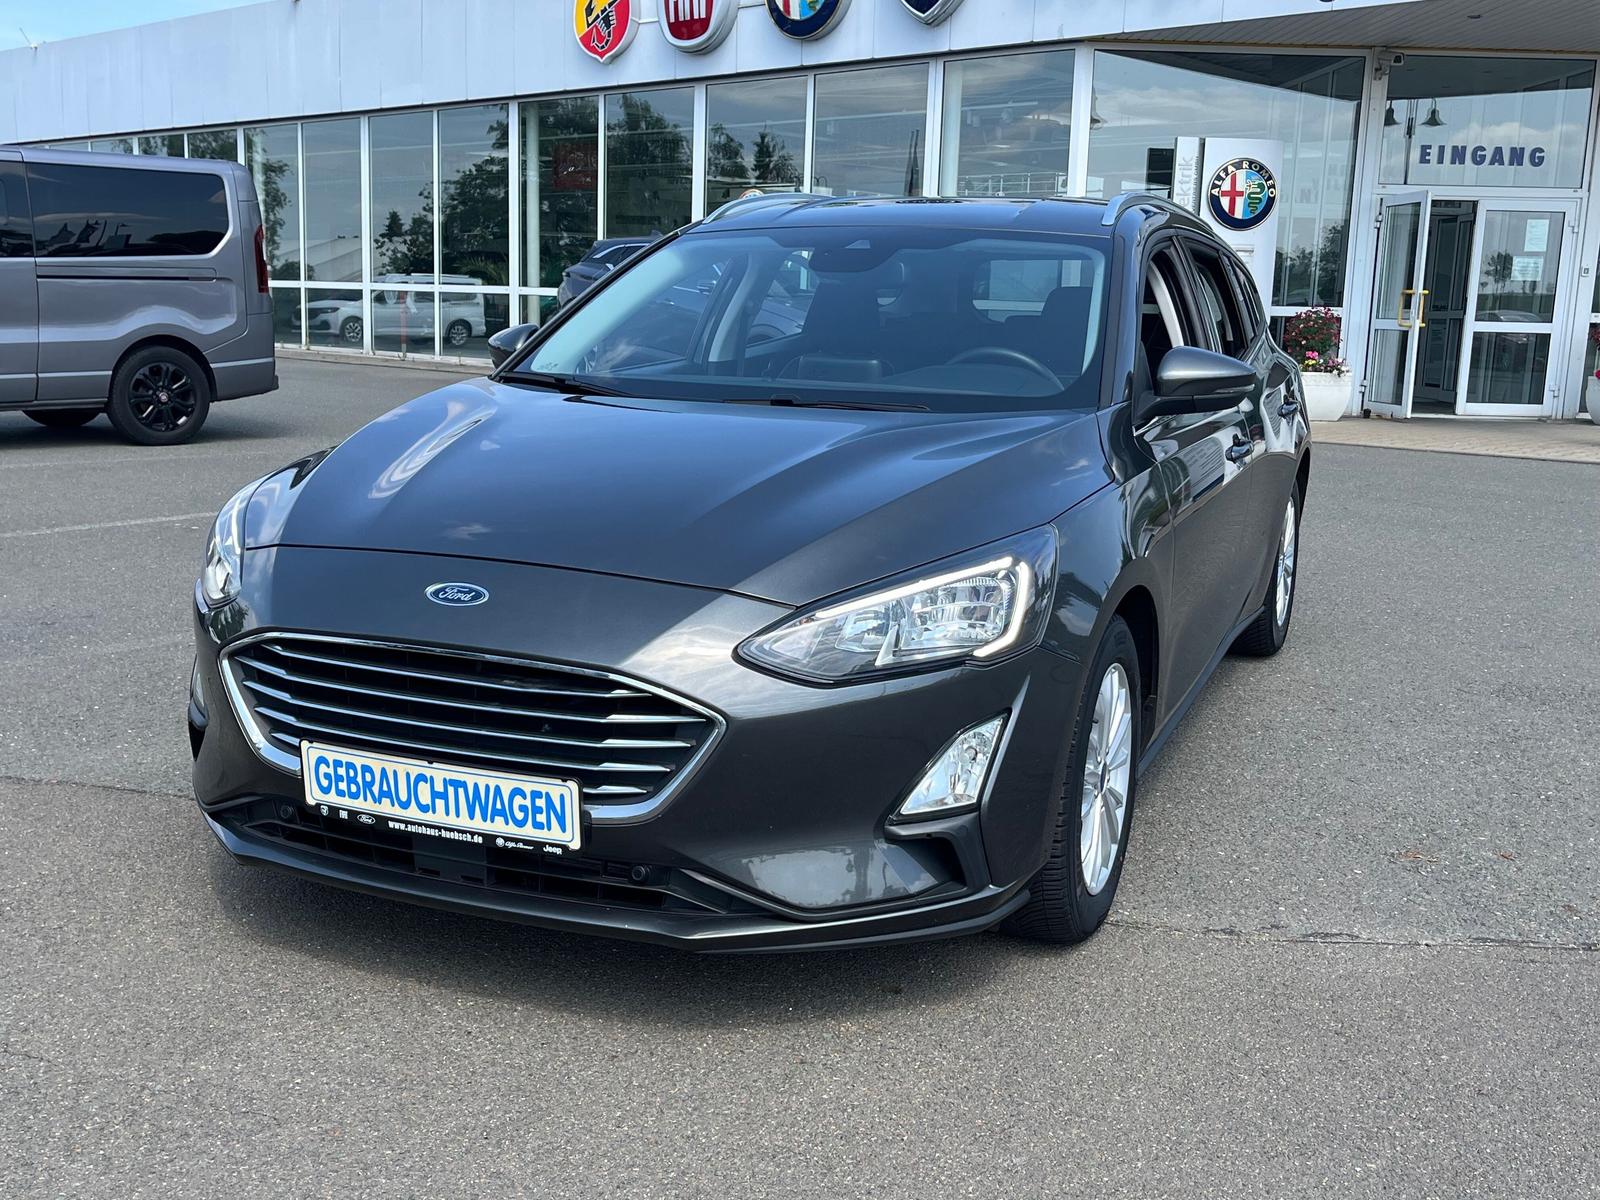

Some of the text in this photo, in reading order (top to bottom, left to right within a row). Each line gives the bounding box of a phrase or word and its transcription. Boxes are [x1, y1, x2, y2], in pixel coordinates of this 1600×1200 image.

[1419, 145, 1545, 167] EINGANG
[1211, 165, 1236, 197] ALFA
[1242, 161, 1276, 197] ROMEO
[438, 586, 475, 601] Ford
[314, 755, 567, 833] GEBRAUCHTWAGEN
[388, 820, 483, 843] www.autohaus-huebsch.de
[543, 844, 562, 855] Jeep
